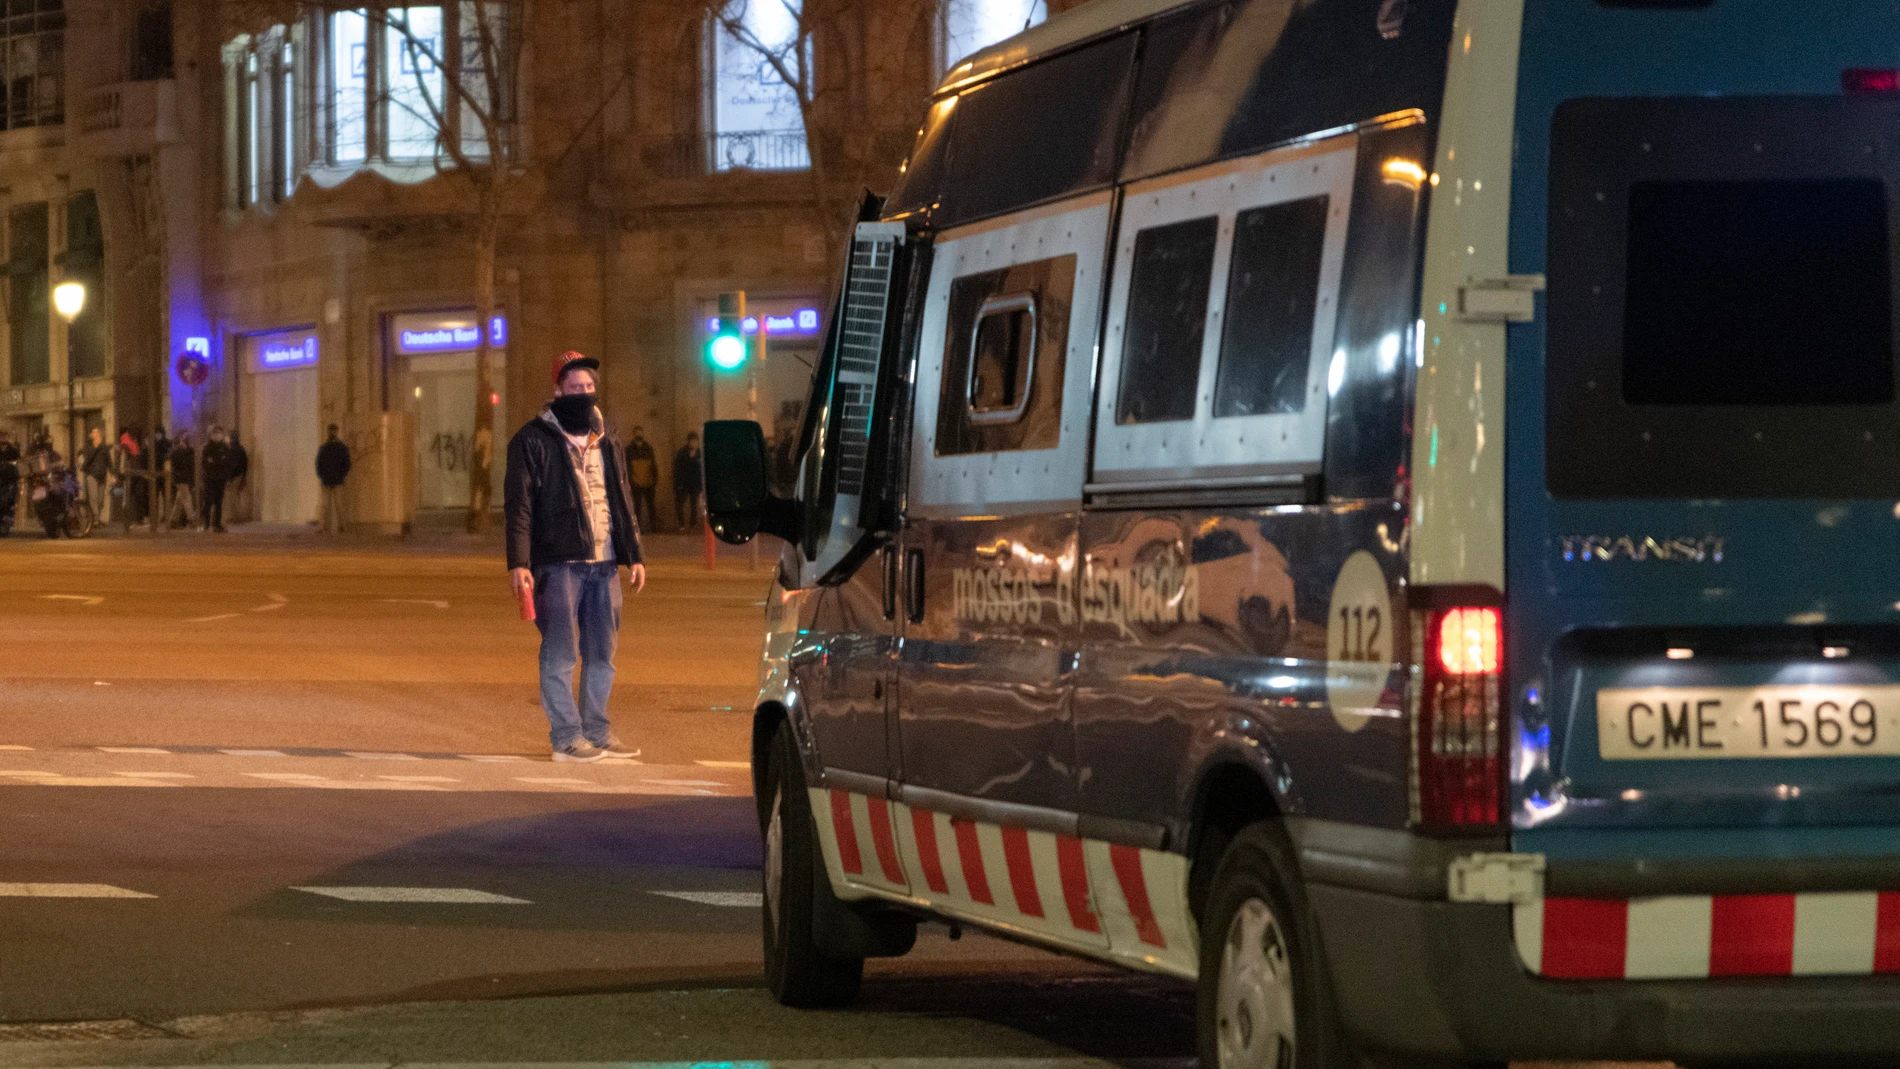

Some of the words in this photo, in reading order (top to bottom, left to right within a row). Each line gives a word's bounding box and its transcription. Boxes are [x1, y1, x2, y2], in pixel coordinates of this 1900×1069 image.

[1560, 534, 1725, 561] TRANSIT
[953, 567, 1042, 624] mossos
[1057, 563, 1201, 637] desquadra
[1340, 606, 1381, 662] 112
[1627, 700, 1723, 748] CME
[1753, 699, 1878, 747] 1569
